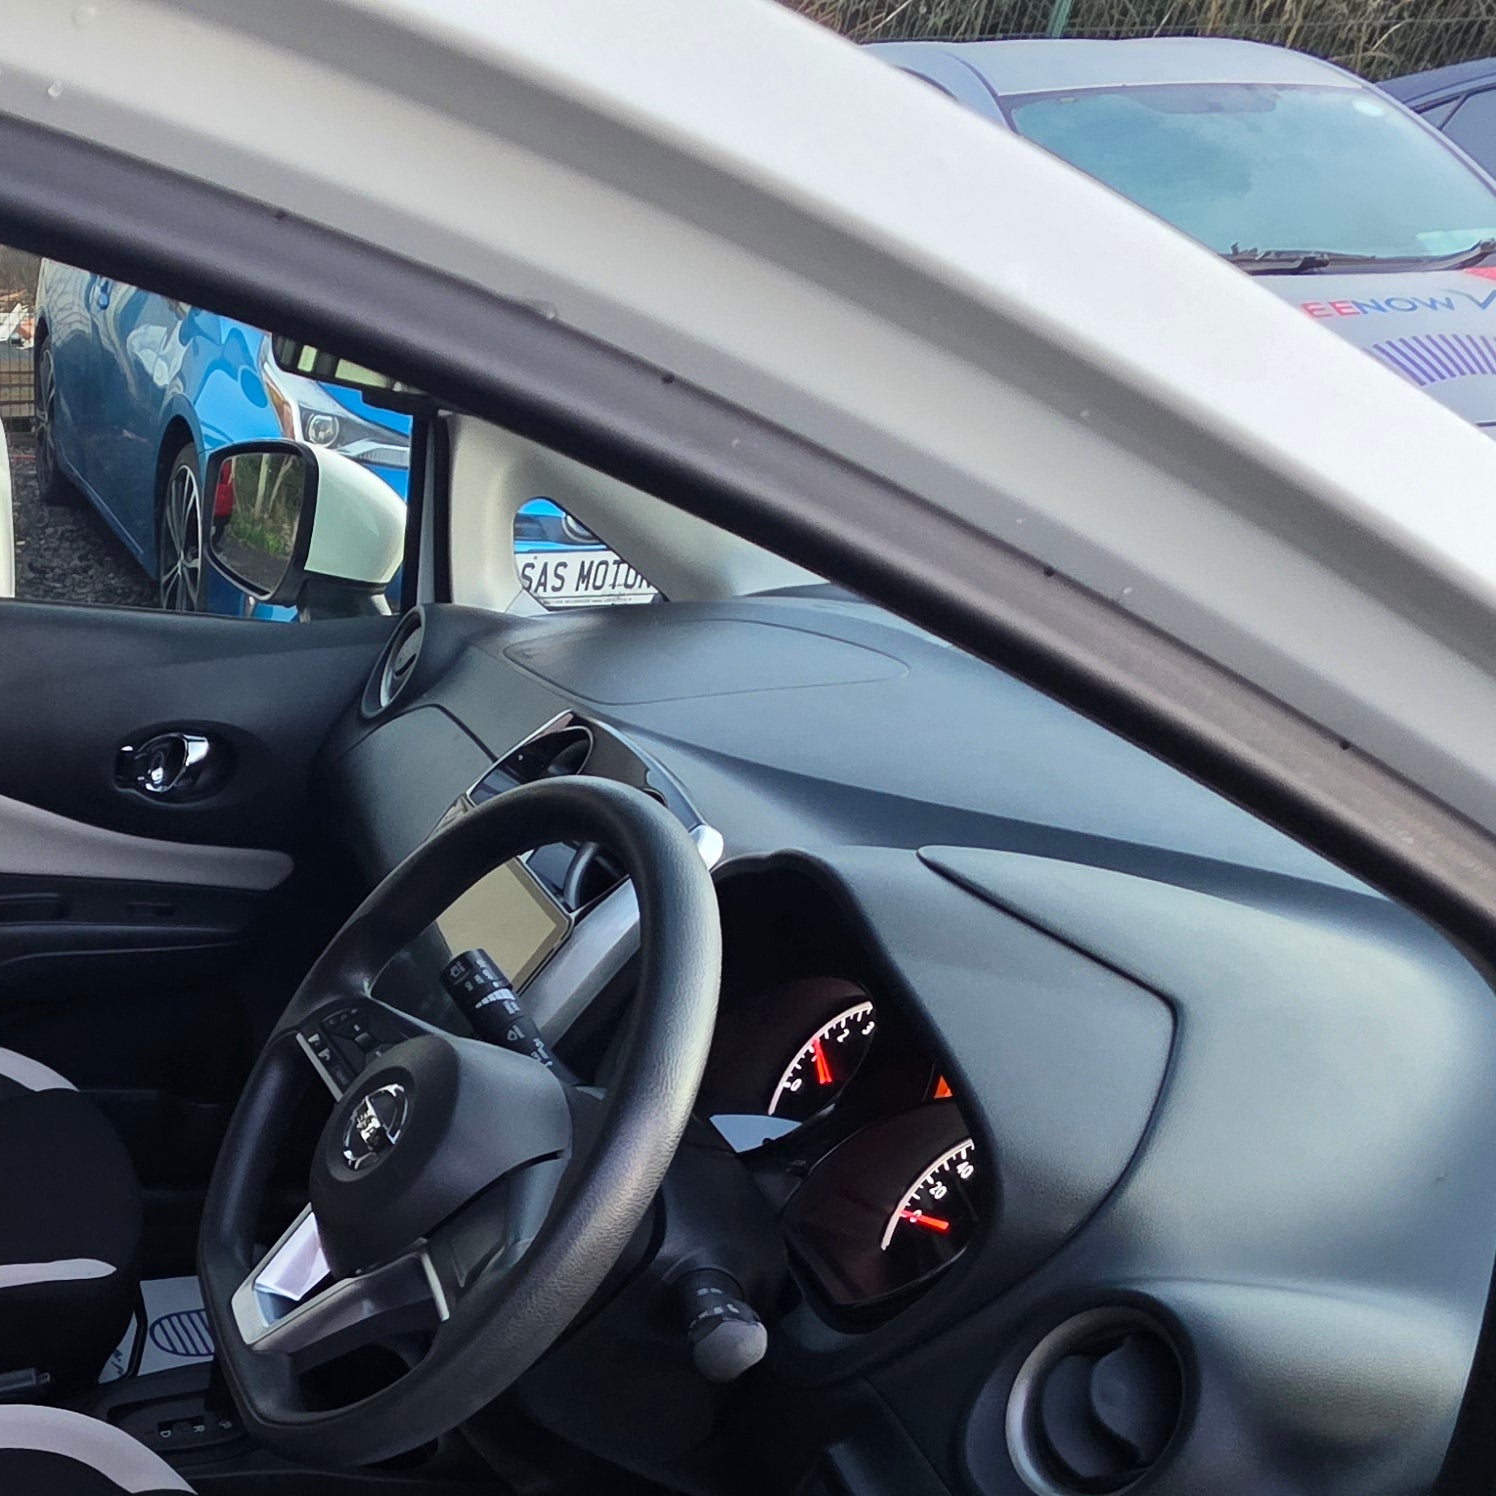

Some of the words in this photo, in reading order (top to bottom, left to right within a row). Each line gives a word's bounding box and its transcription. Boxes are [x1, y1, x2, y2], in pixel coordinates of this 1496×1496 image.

[521, 561, 568, 593] SAS
[837, 1028, 850, 1043] 2
[861, 1020, 875, 1035] 3
[790, 1078, 802, 1092] 0
[956, 1161, 974, 1179] 40
[929, 1181, 947, 1200] 20
